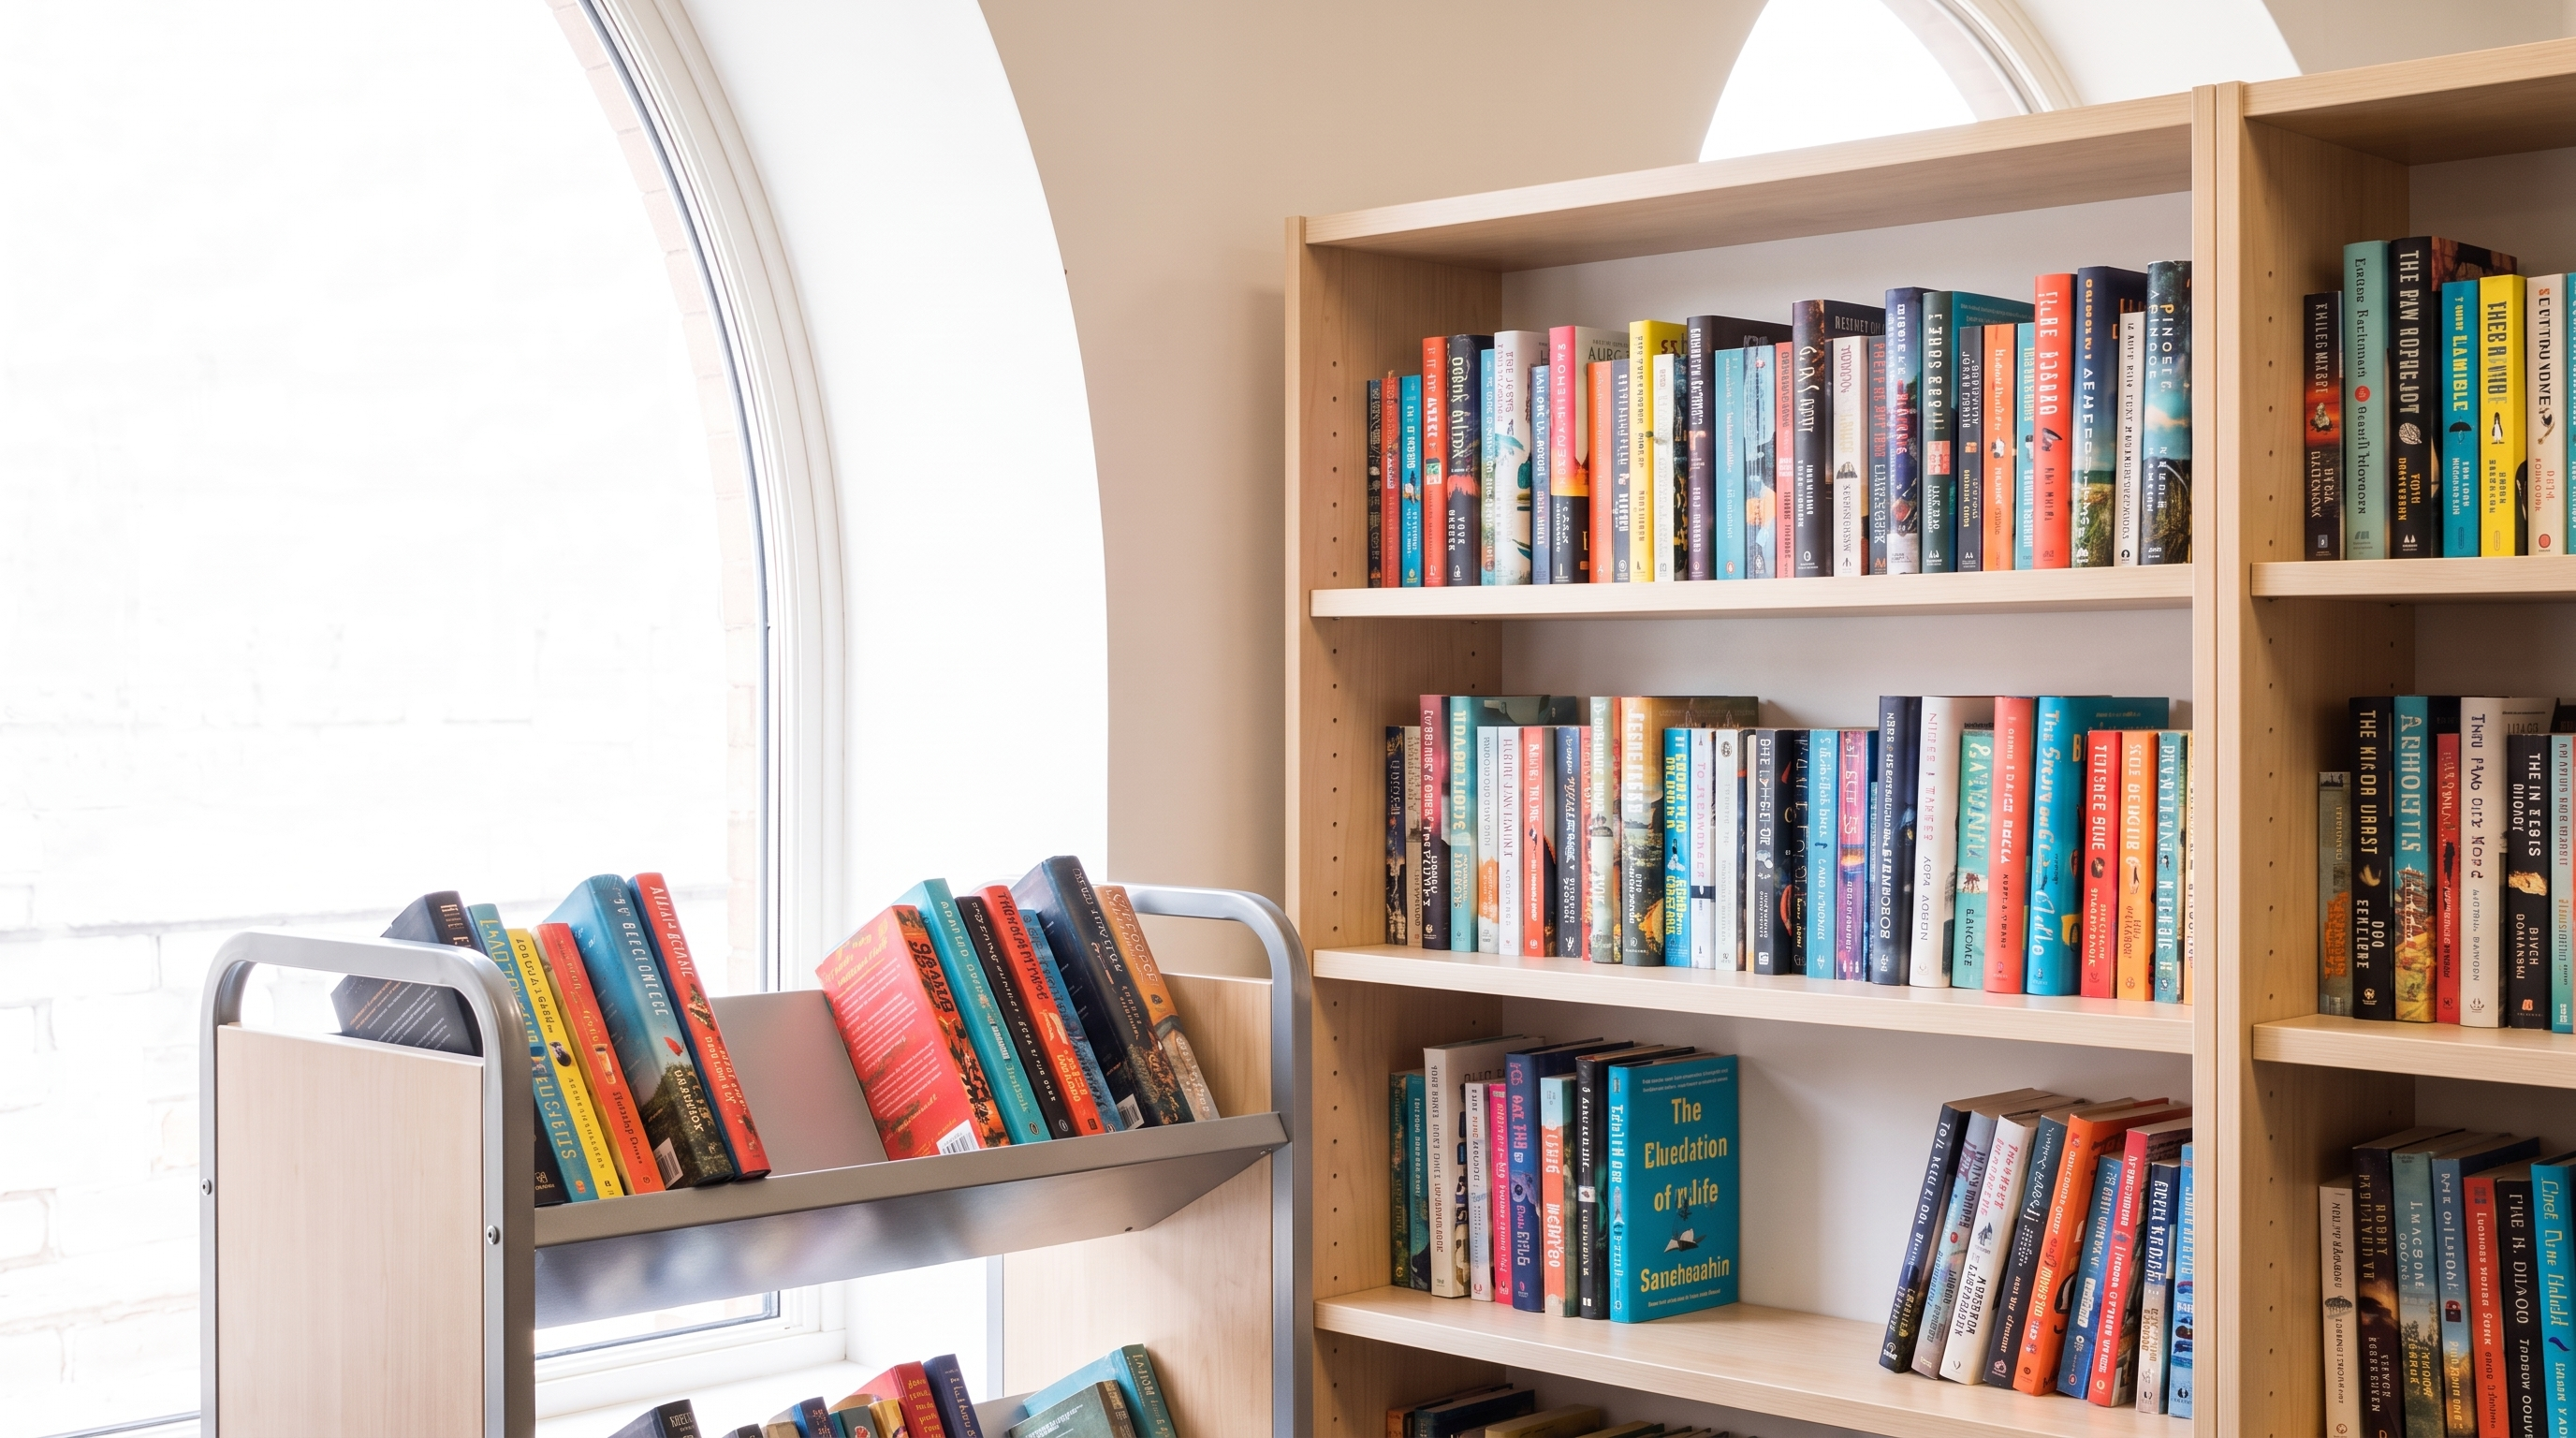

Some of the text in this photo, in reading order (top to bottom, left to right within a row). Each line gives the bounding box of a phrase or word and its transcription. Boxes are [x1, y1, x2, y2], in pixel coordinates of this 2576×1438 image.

[2399, 250, 2420, 284] THE
[2360, 710, 2377, 739] THE
[2528, 753, 2541, 781] THE
[1671, 1097, 1702, 1124] The
[1653, 1183, 1672, 1212] of
